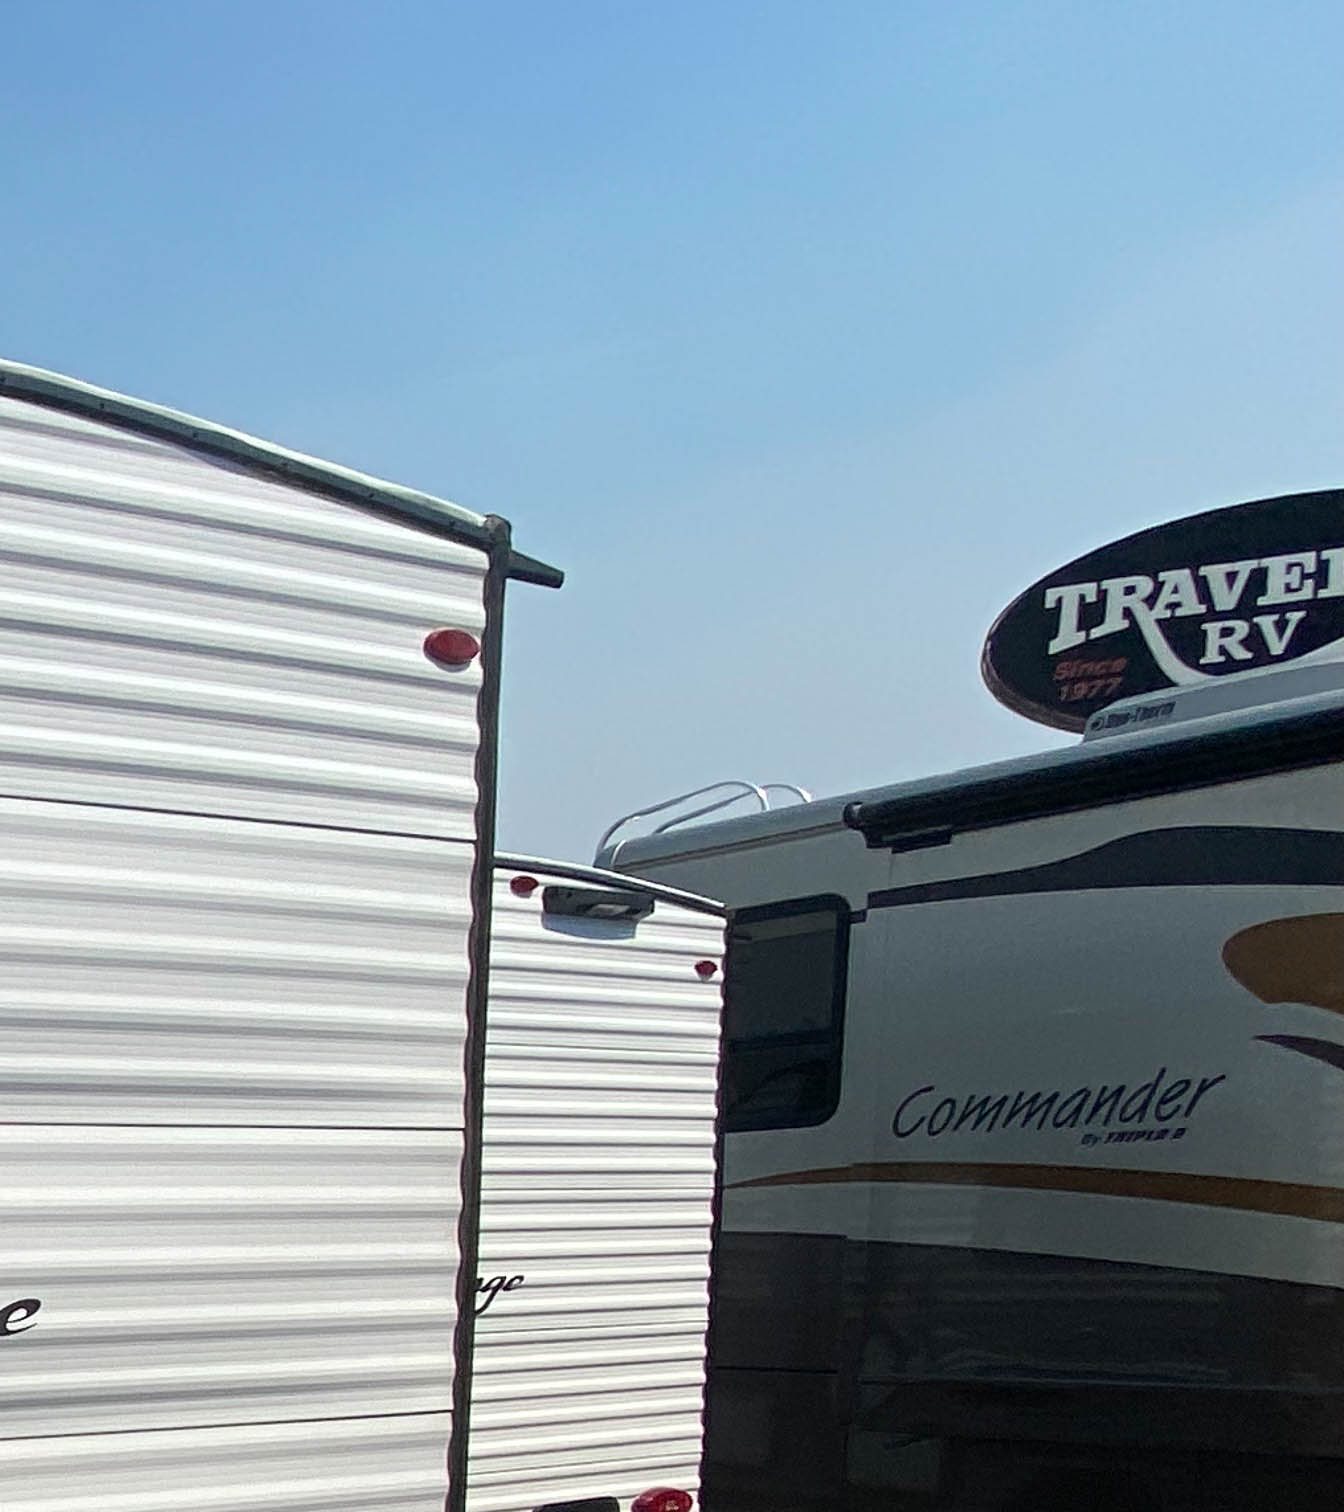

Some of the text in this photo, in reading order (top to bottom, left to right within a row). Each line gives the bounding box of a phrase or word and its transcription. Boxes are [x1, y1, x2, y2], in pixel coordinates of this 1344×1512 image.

[1199, 610, 1308, 665] RV
[1053, 656, 1129, 682] Since
[1059, 676, 1123, 702] 1977
[891, 1066, 1227, 1138] Commander
